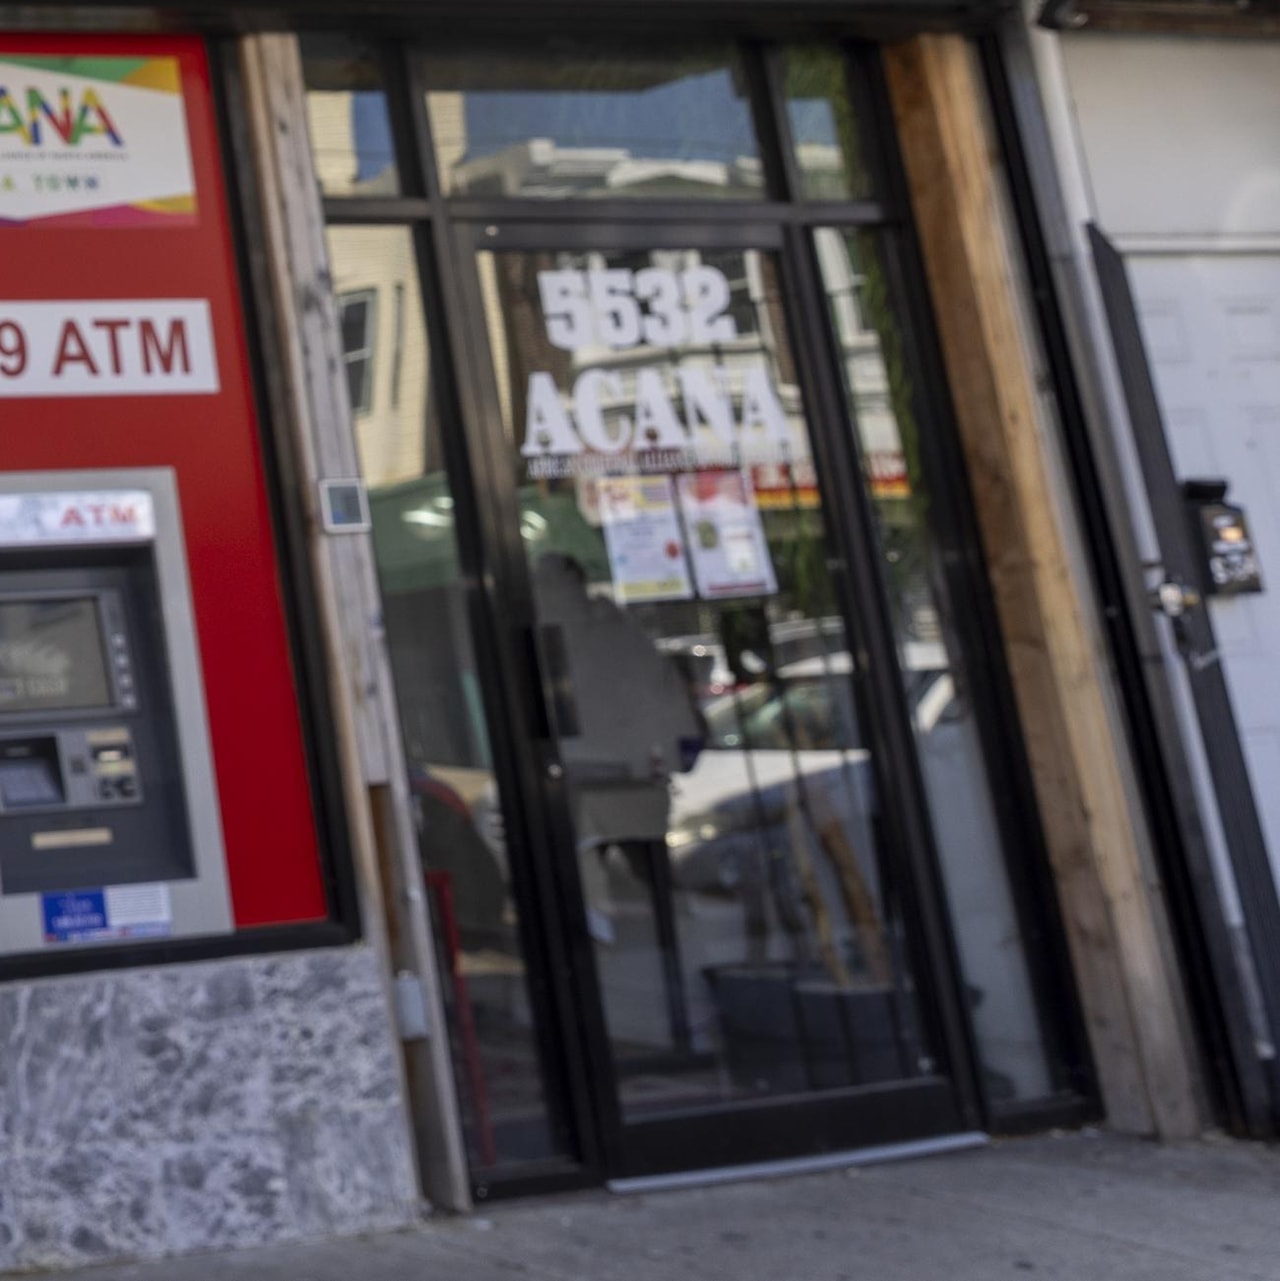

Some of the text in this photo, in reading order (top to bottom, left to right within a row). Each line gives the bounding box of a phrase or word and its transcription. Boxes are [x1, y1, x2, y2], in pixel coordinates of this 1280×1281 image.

[536, 262, 739, 352] 5532
[51, 318, 193, 379] ATM
[519, 356, 792, 457] ACANA
[60, 503, 140, 530] ATM
